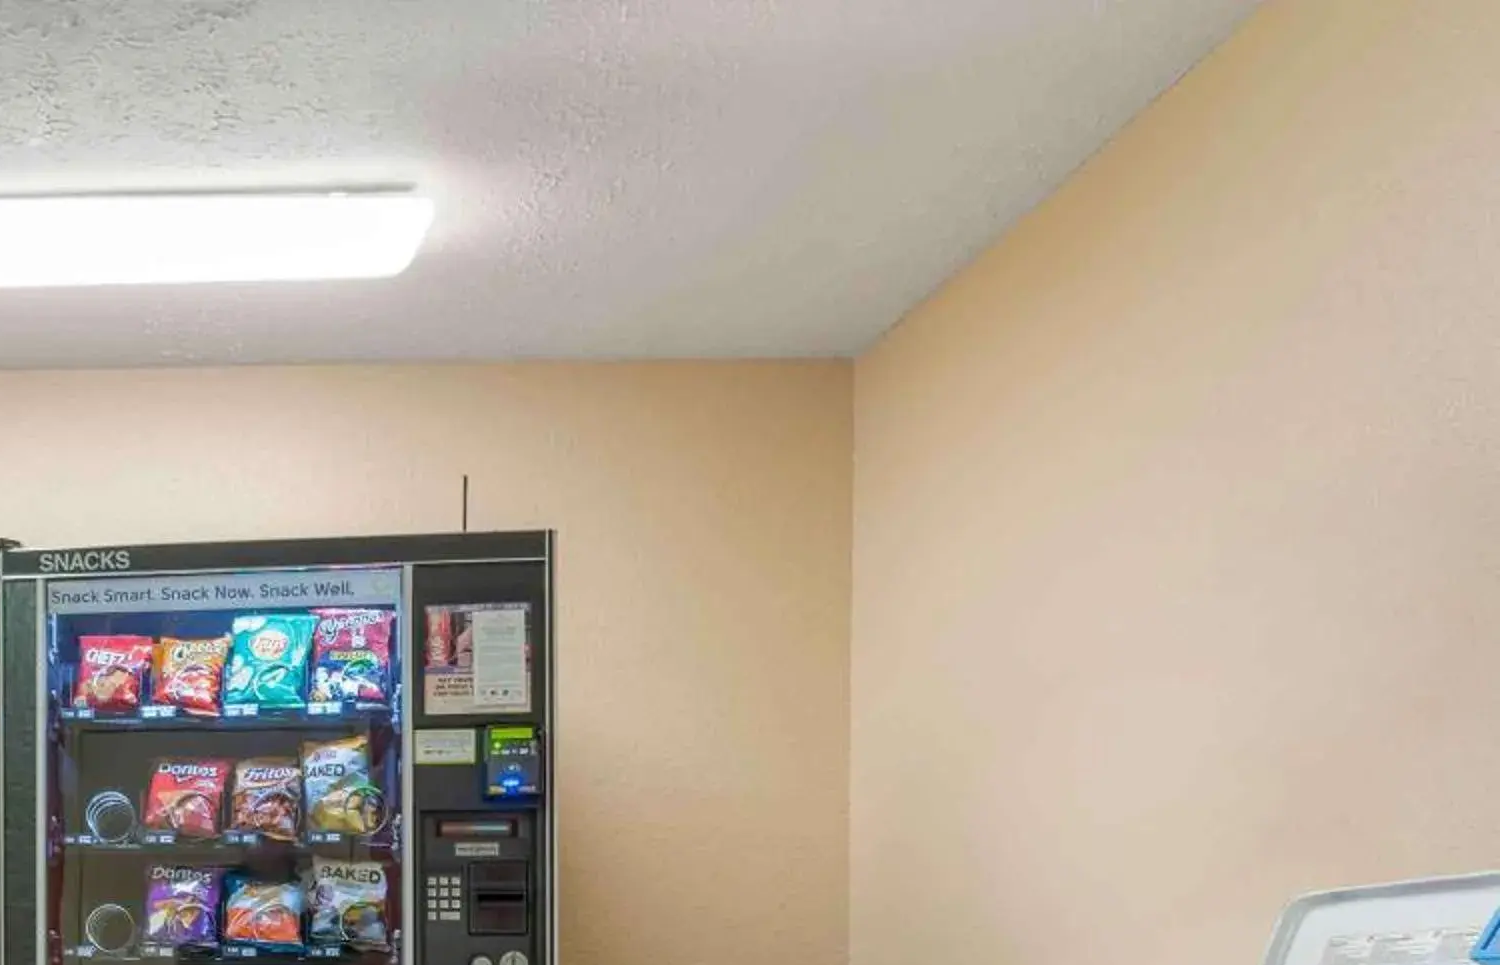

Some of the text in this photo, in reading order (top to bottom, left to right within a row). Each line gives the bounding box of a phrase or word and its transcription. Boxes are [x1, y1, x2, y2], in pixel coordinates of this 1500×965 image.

[39, 550, 131, 572] SNACKS
[51, 590, 98, 605] Snack
[161, 585, 211, 601] Snack
[215, 584, 254, 600] Now.
[259, 582, 309, 598] Snack
[314, 580, 355, 597] Well.
[158, 763, 218, 778] Doritos
[152, 866, 213, 884] Doritos
[320, 865, 382, 884] BAKED
